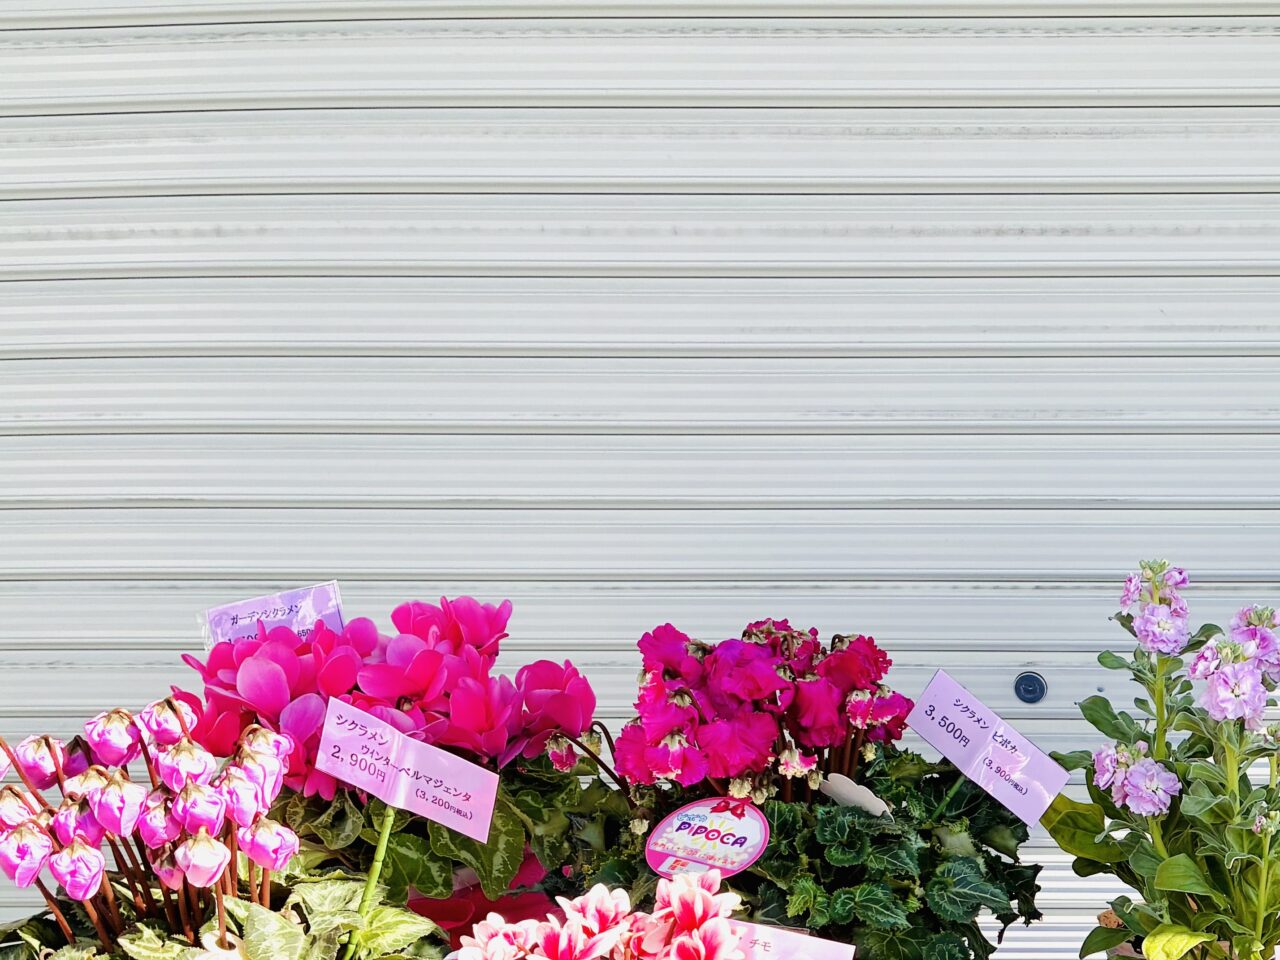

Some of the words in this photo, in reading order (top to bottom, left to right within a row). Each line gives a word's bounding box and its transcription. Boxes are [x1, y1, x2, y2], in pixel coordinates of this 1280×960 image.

[230, 604, 303, 626] ガーデンシクラメン
[335, 713, 390, 746] シクラメン
[924, 704, 971, 748] 3,500円
[953, 698, 990, 730] シクラメン
[992, 731, 1018, 755] ピポカ
[331, 744, 387, 783] 2,900円
[982, 756, 1029, 796] (3,900円税込)
[415, 788, 473, 821] (3,200円税込)
